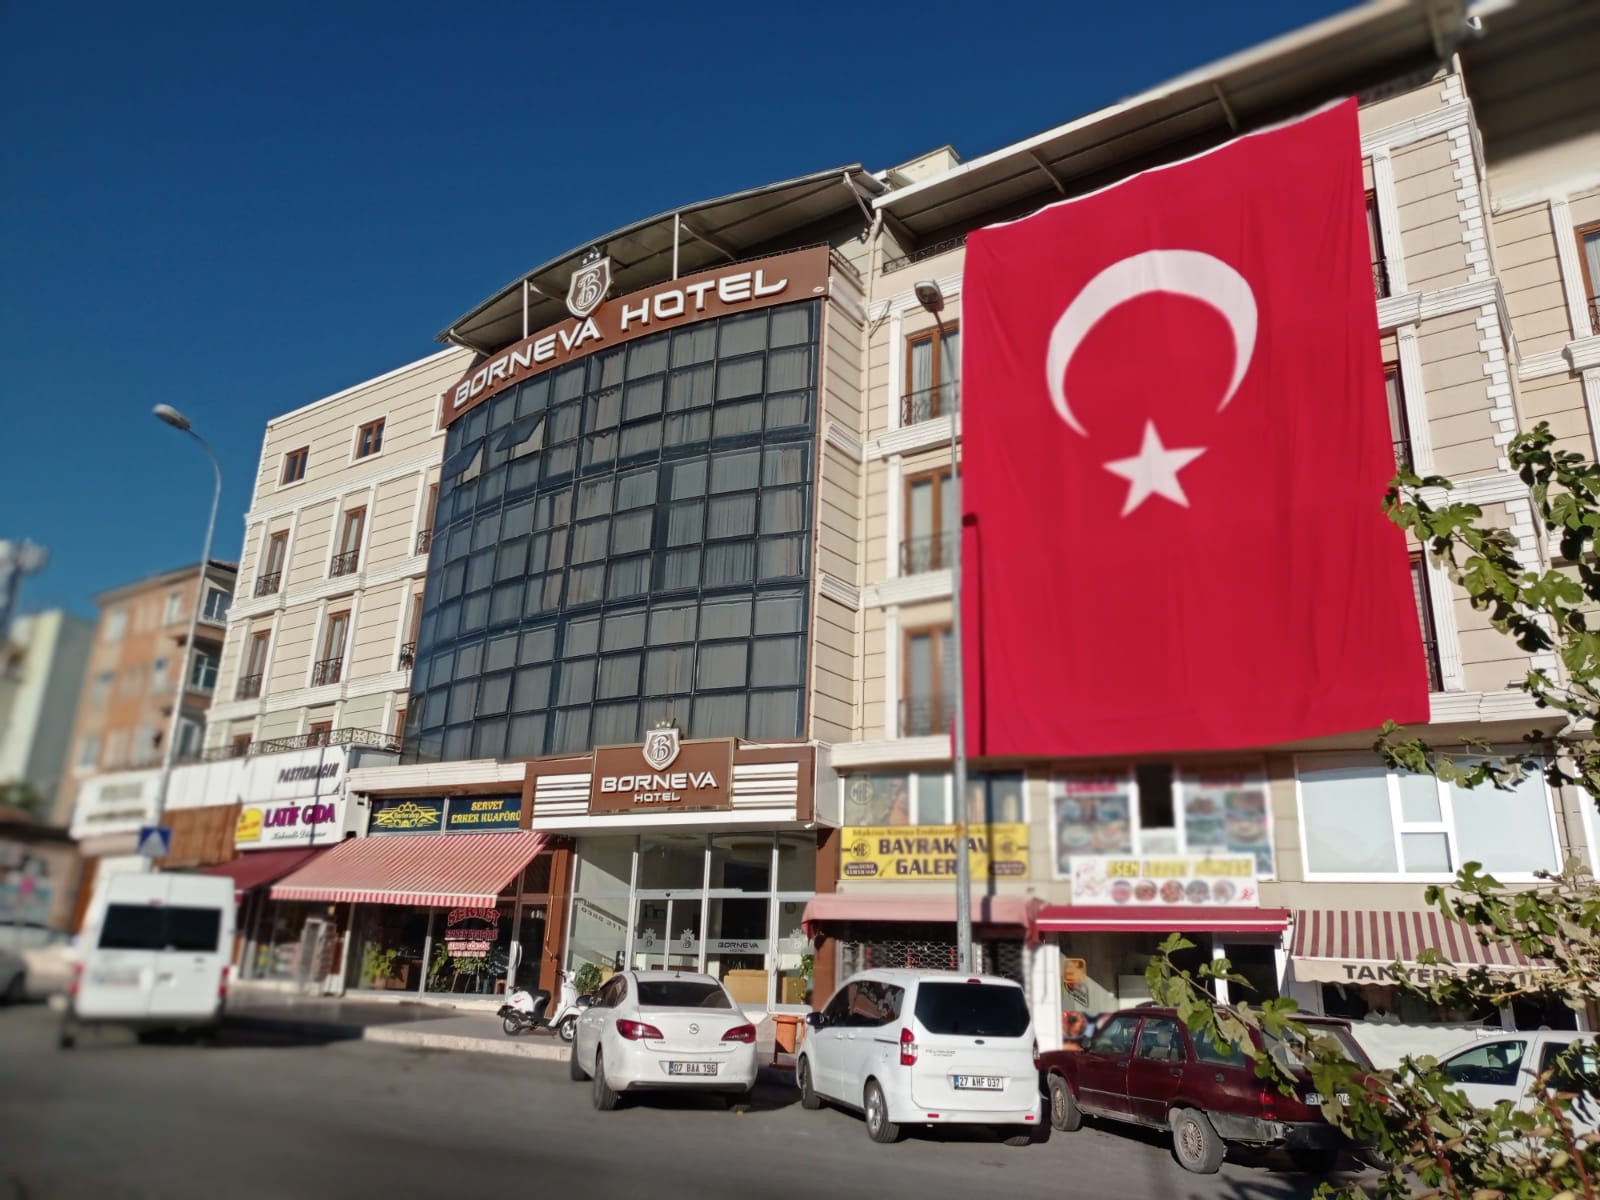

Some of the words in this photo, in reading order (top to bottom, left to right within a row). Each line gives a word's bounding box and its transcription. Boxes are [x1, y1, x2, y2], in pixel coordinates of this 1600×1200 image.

[453, 316, 602, 410] BORNEVA
[620, 268, 789, 331] HOTEL
[600, 771, 719, 793] BORNEVA
[633, 792, 681, 803] HOTEL
[471, 800, 504, 811] SERVET
[451, 813, 480, 824] ERKEK
[878, 837, 957, 855] BAYRAK
[895, 858, 958, 876] GALER
[718, 941, 759, 949] BORNEVA
[674, 1063, 683, 1073] 07
[687, 1063, 700, 1073] BAA
[959, 1076, 969, 1087] 27
[972, 1077, 985, 1087] AHF
[987, 1078, 1000, 1088] 037
